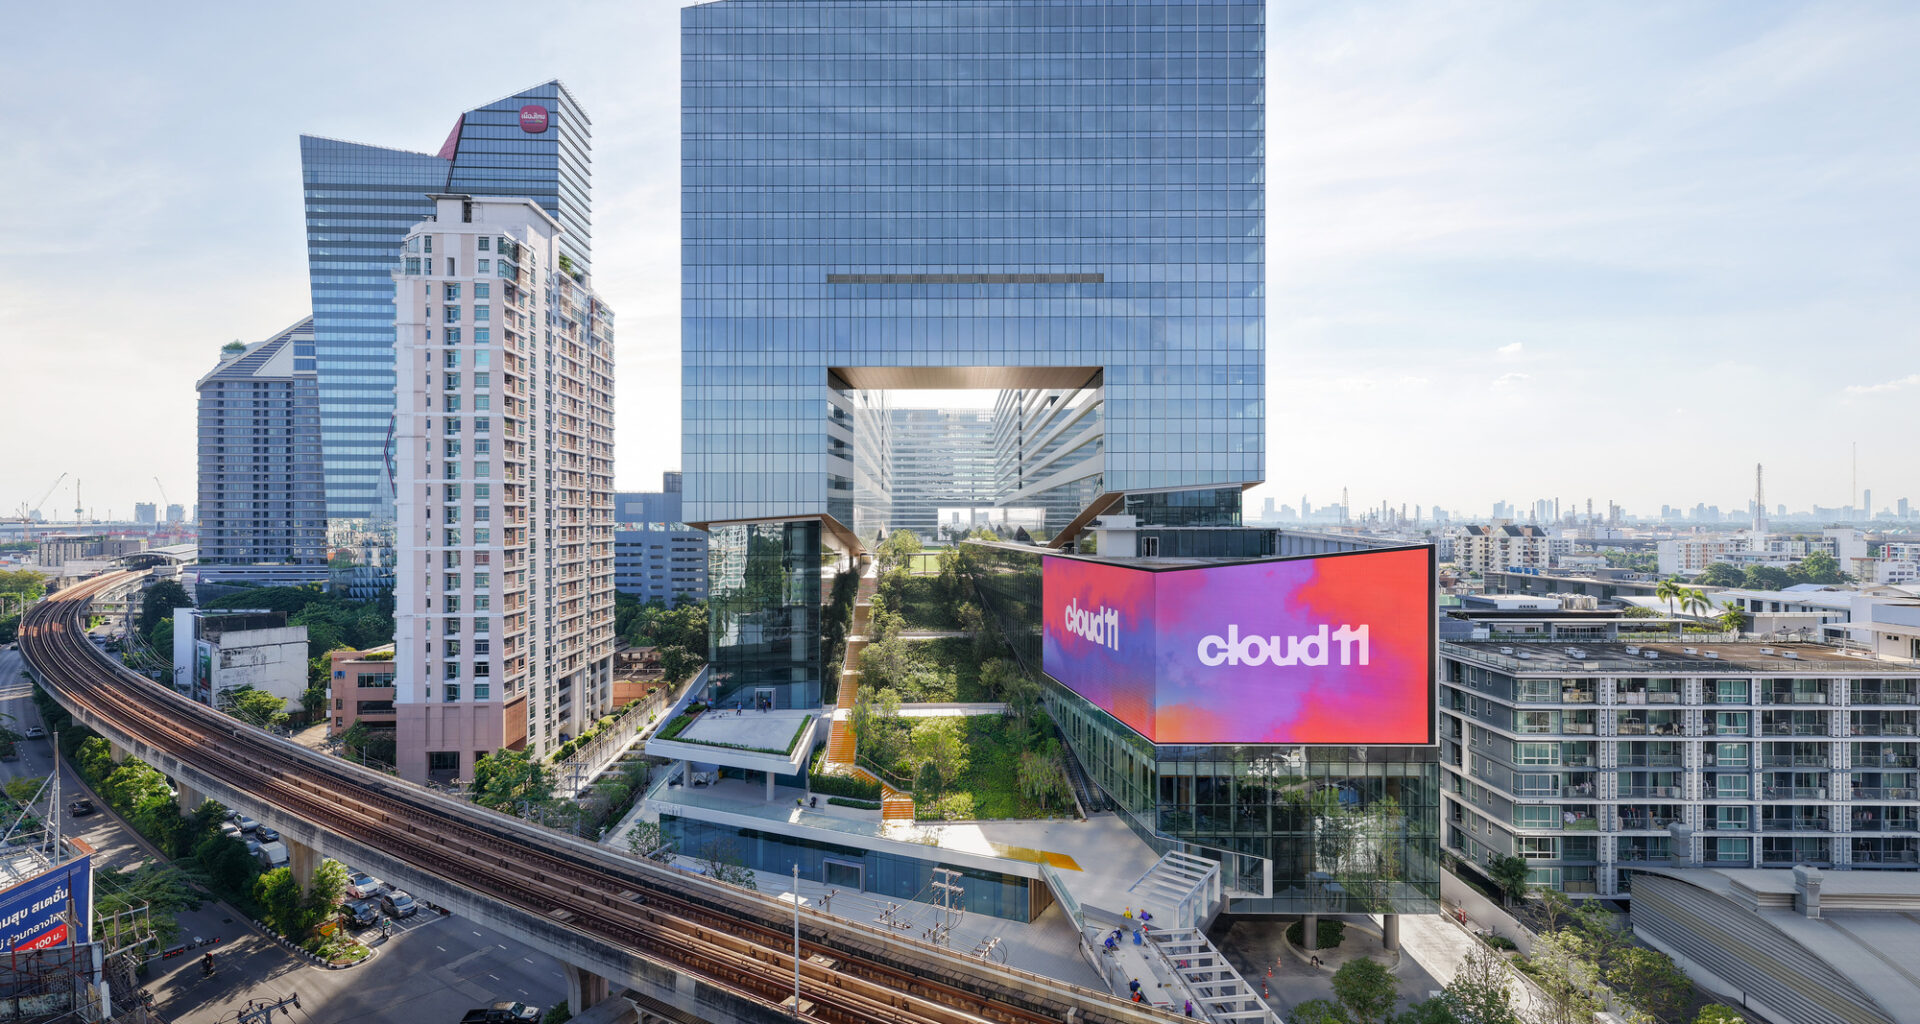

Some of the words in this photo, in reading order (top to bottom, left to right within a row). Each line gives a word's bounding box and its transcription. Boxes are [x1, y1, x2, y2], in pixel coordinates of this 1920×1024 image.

[1065, 598, 1118, 651] cloud11
[1197, 624, 1369, 667] cloud11
[0, 908, 28, 929] มสุข
[35, 937, 51, 949] 100
